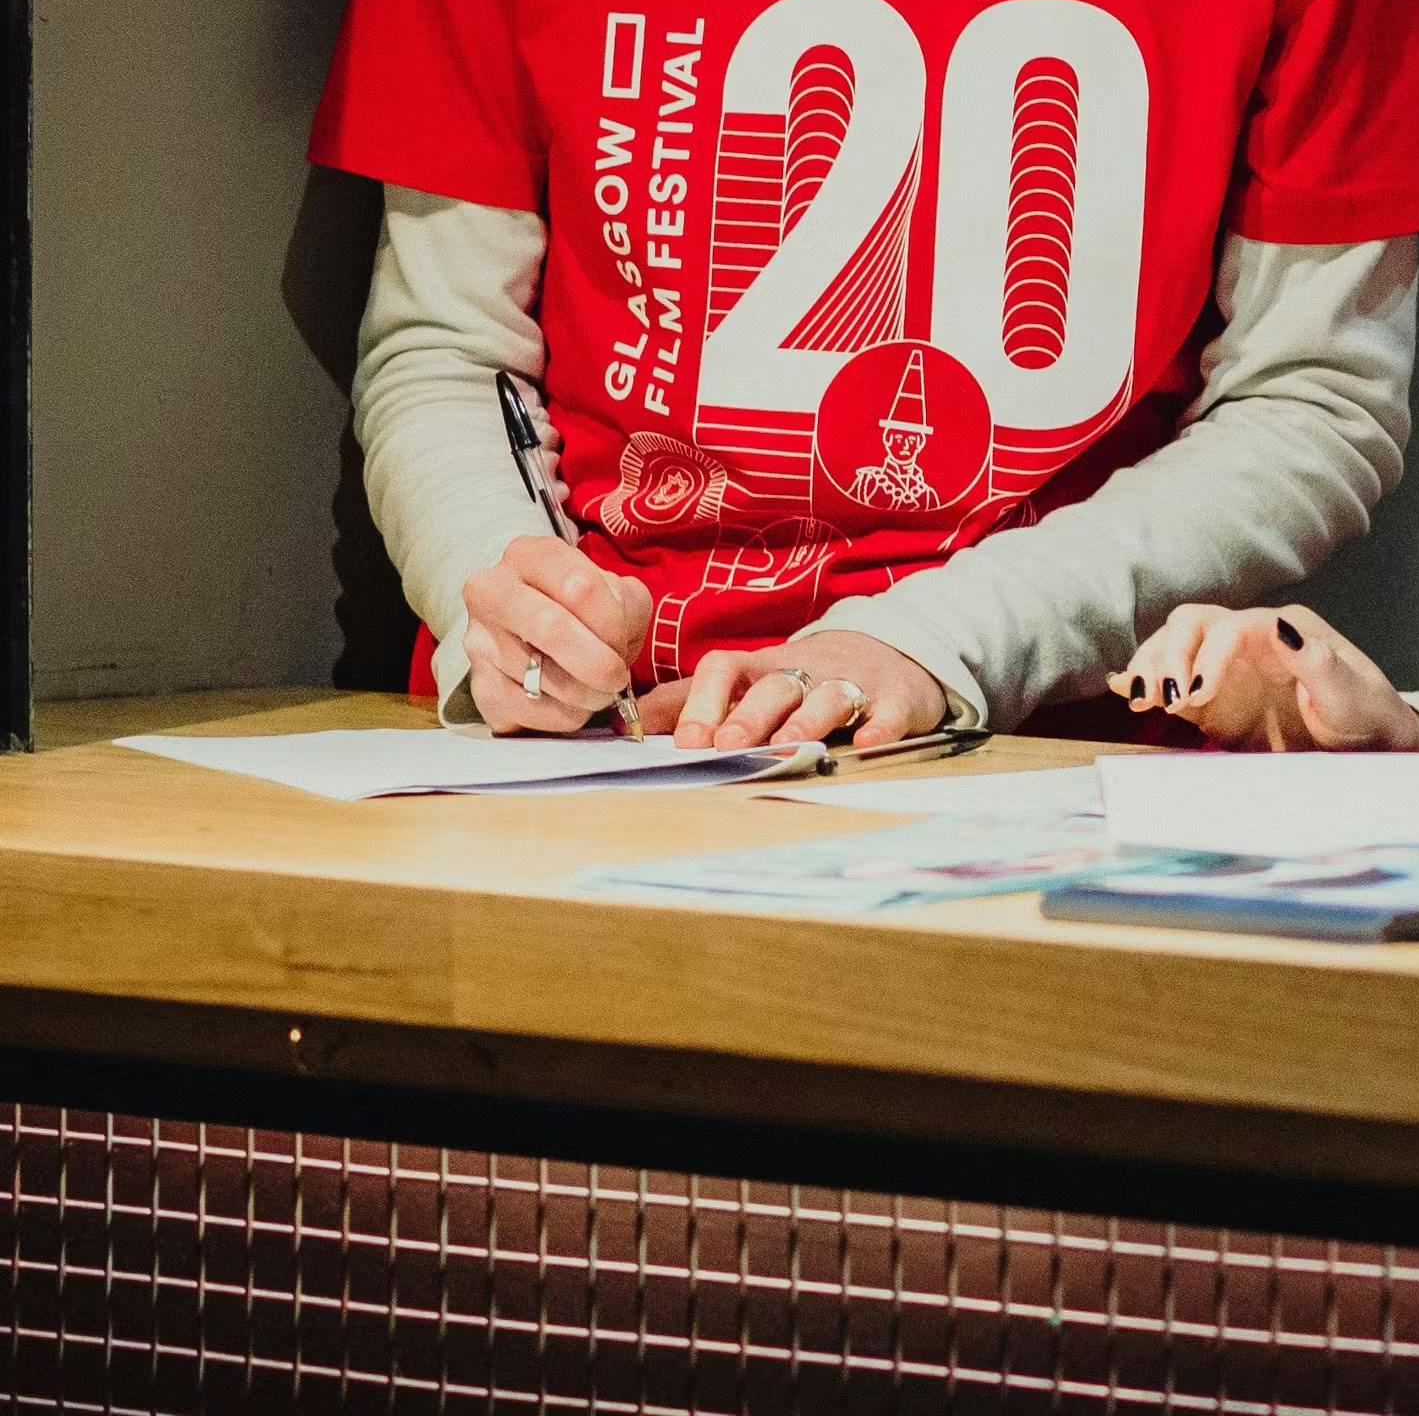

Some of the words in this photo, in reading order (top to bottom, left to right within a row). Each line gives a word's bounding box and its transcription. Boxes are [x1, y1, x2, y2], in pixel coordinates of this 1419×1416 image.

[594, 117, 648, 401] GLASGOW
[646, 17, 705, 270] FESTIVAL
[643, 287, 683, 417] FILM
